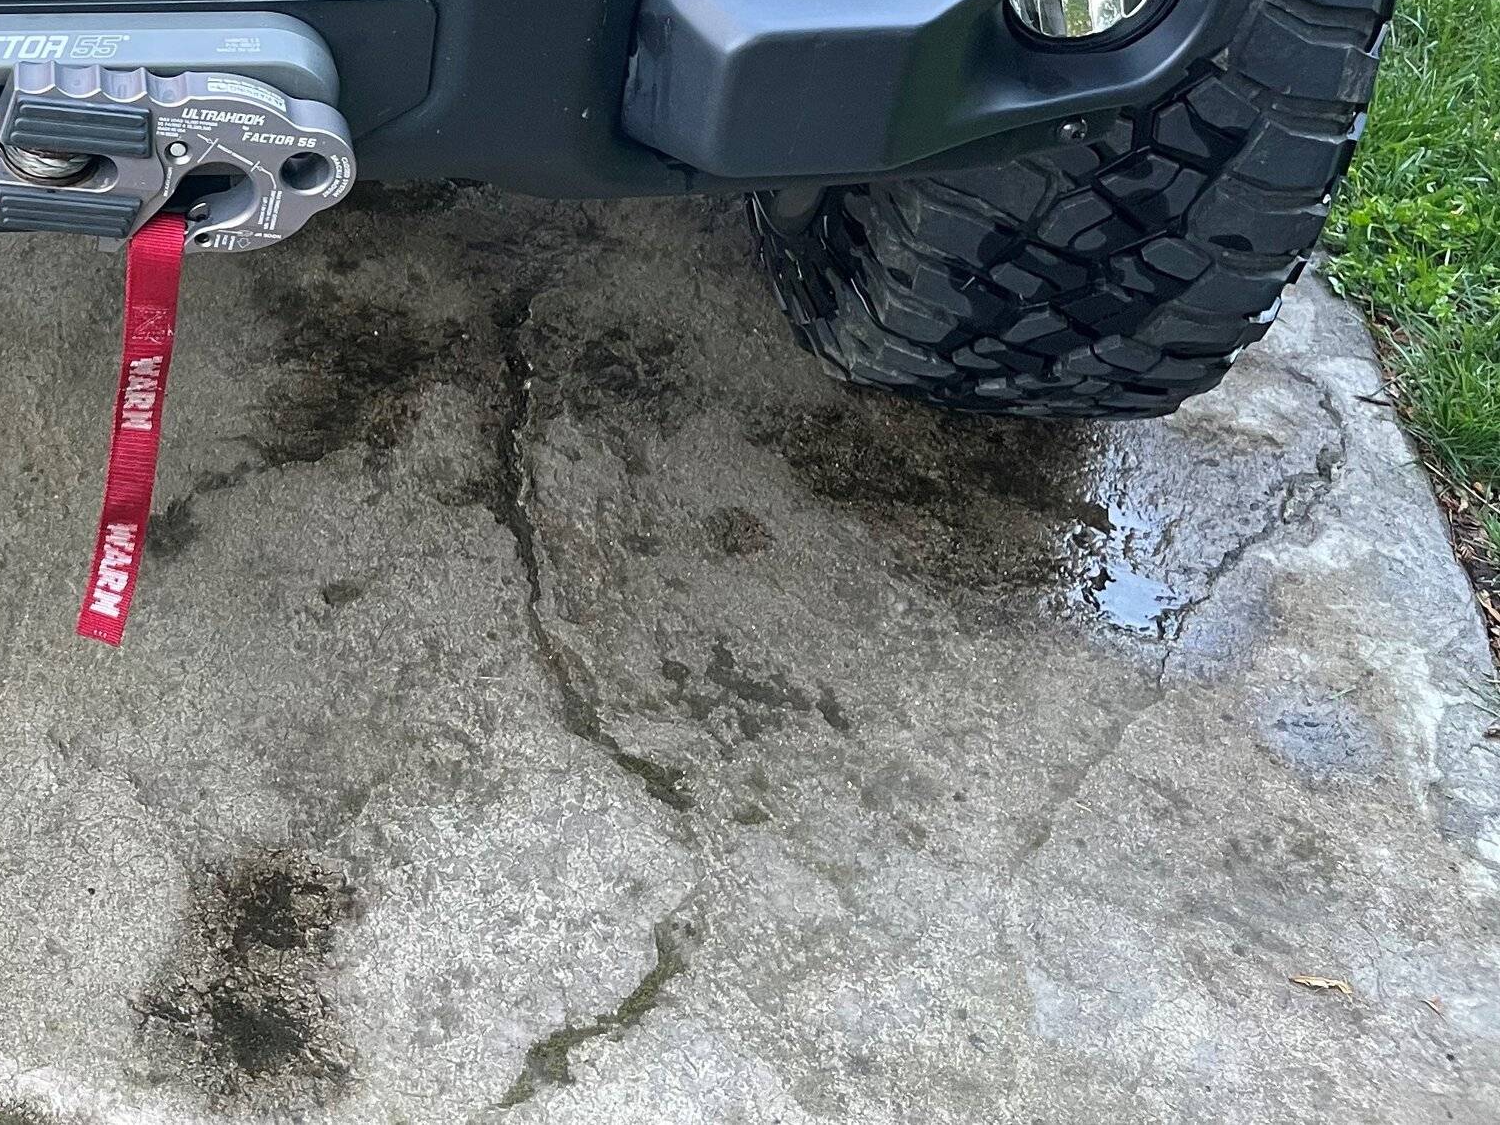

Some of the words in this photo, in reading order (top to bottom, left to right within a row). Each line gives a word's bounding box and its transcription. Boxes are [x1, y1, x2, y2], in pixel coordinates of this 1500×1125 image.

[70, 34, 123, 59] 55
[181, 107, 266, 127] ULTRAHOOK
[241, 131, 295, 146] FACTOR
[297, 137, 317, 149] 55
[122, 355, 164, 430] WARN
[89, 523, 139, 618] WARN
